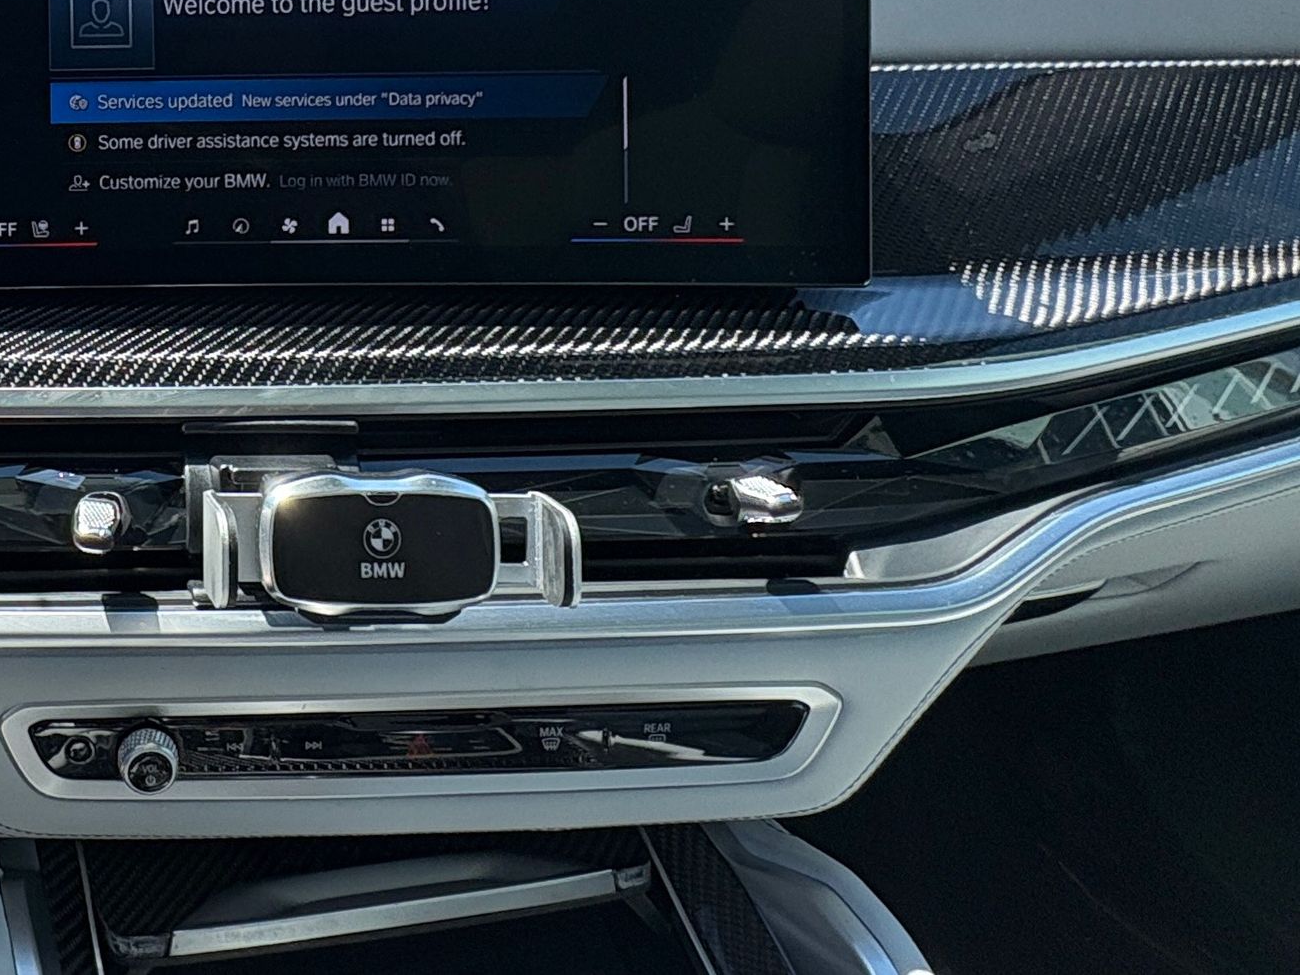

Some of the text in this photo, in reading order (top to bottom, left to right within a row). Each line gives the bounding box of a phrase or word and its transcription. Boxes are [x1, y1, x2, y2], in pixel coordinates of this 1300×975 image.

[97, 94, 164, 110] Services
[168, 93, 233, 111] updated
[242, 94, 272, 107] New
[275, 93, 332, 107] services
[335, 92, 377, 107] under
[98, 130, 466, 150] Some driver assistance systems are turned off.
[99, 173, 452, 192] Customize your BMW. Log in with BMW ID now.
[623, 216, 659, 232] OFF
[360, 562, 405, 579] BMW
[539, 727, 564, 737] MAX
[644, 723, 672, 733] REAR
